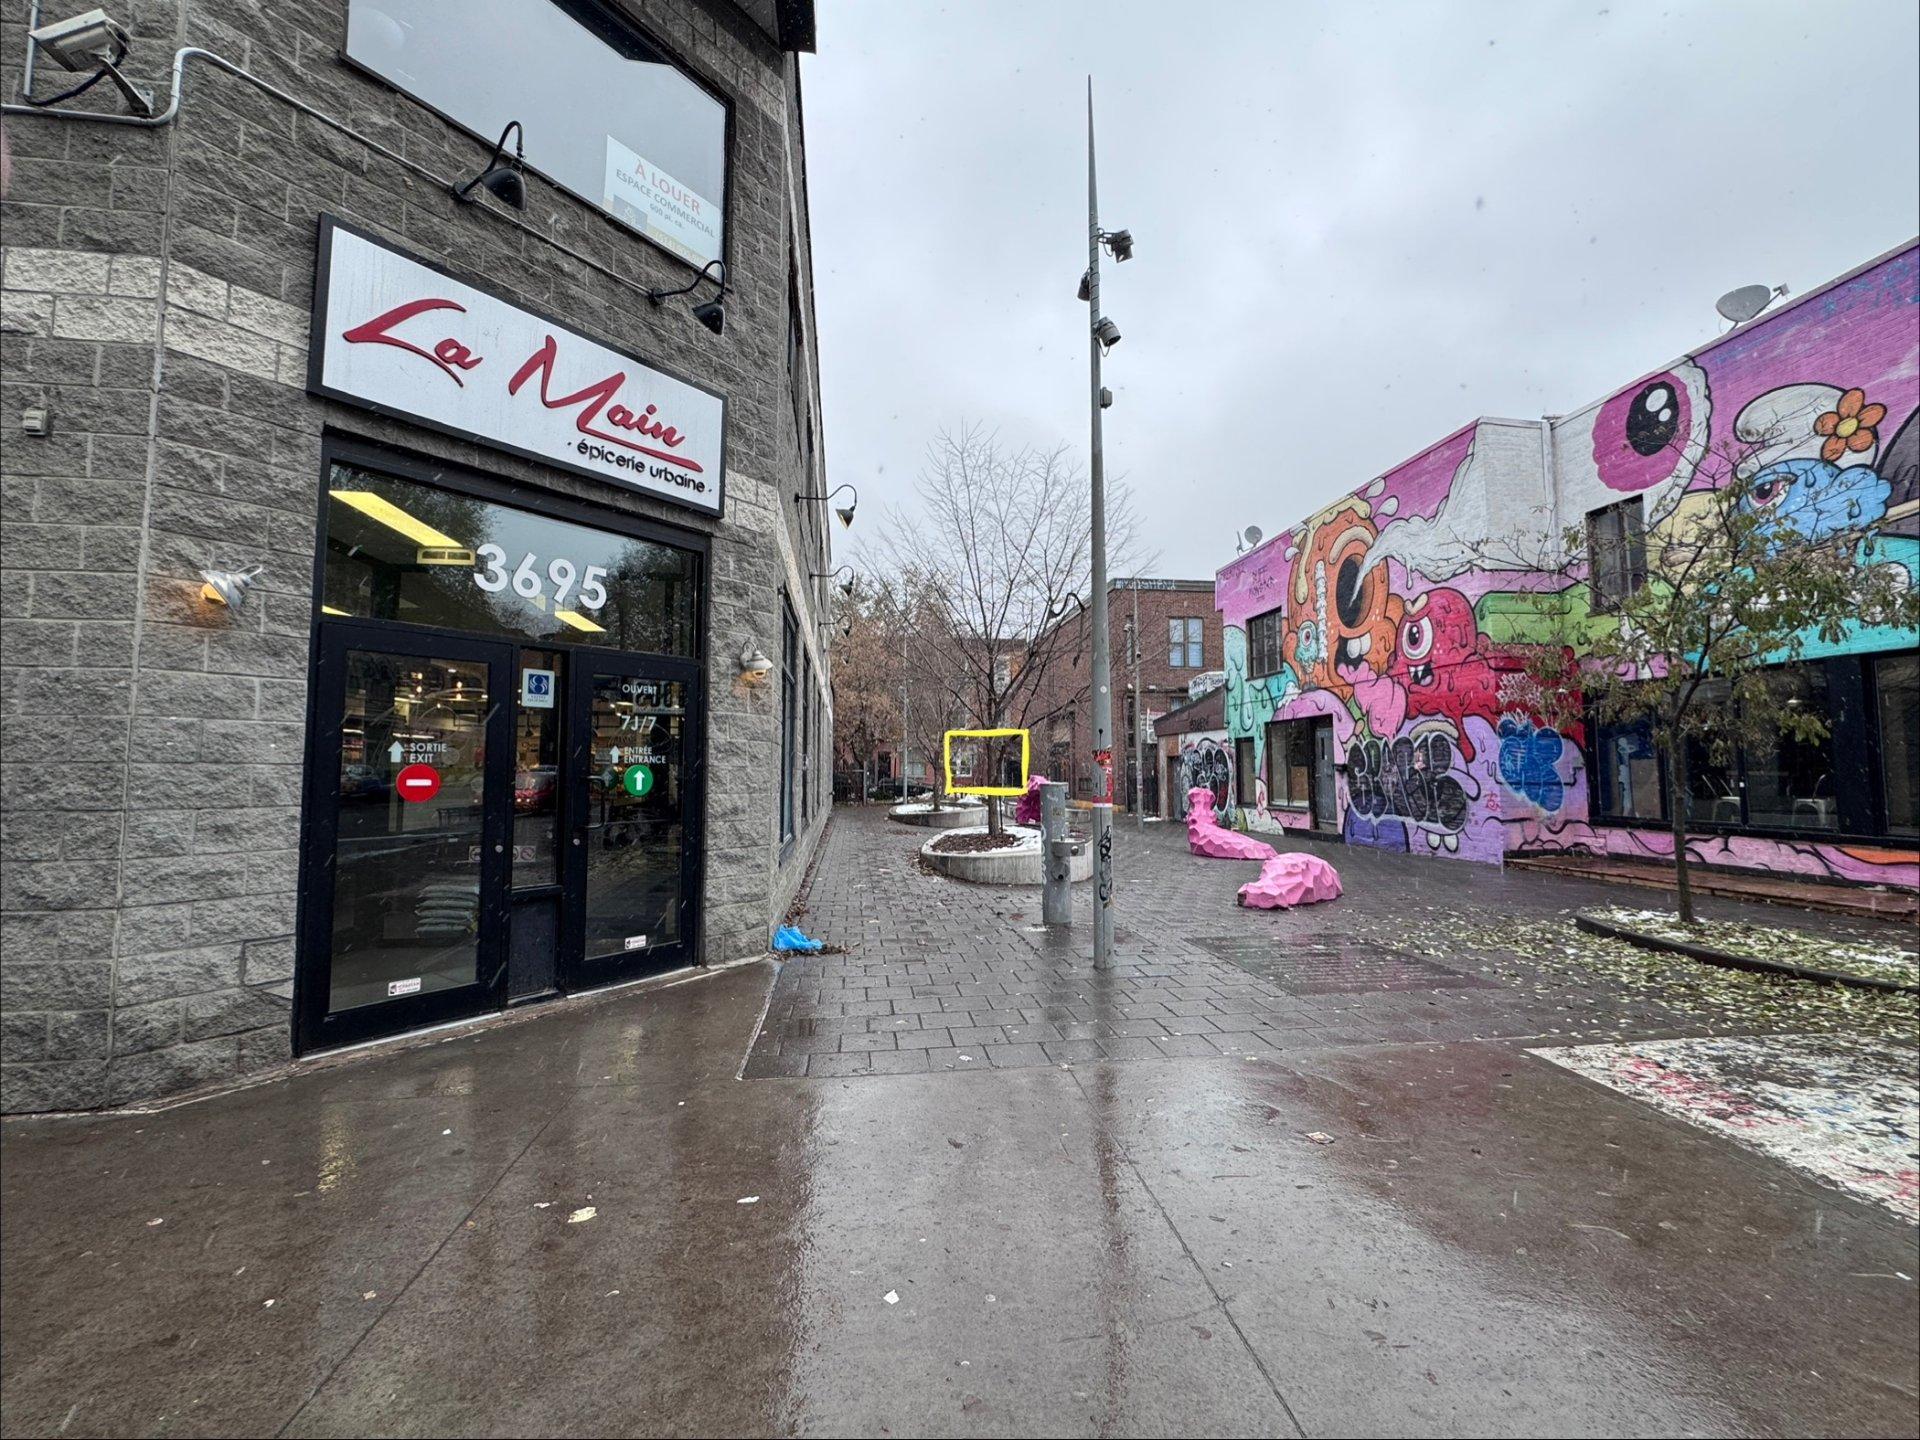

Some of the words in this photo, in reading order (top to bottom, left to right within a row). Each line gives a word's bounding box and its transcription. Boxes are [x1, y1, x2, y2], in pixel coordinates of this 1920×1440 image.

[616, 168, 652, 198] ESPACE
[654, 193, 716, 238] COMMERCIAL
[652, 172, 700, 215] LOUER
[342, 298, 483, 388] La
[508, 334, 703, 473] Main
[577, 438, 645, 473] épicerie
[650, 465, 705, 493] urbaine
[473, 543, 607, 610] 3695
[622, 684, 657, 695] OUVERT
[621, 715, 657, 734] 7J/7
[410, 742, 448, 753] SORTIE
[624, 745, 652, 755] ENTRÉE
[409, 753, 434, 763] EXIT
[624, 755, 666, 764] ENTRANCE
